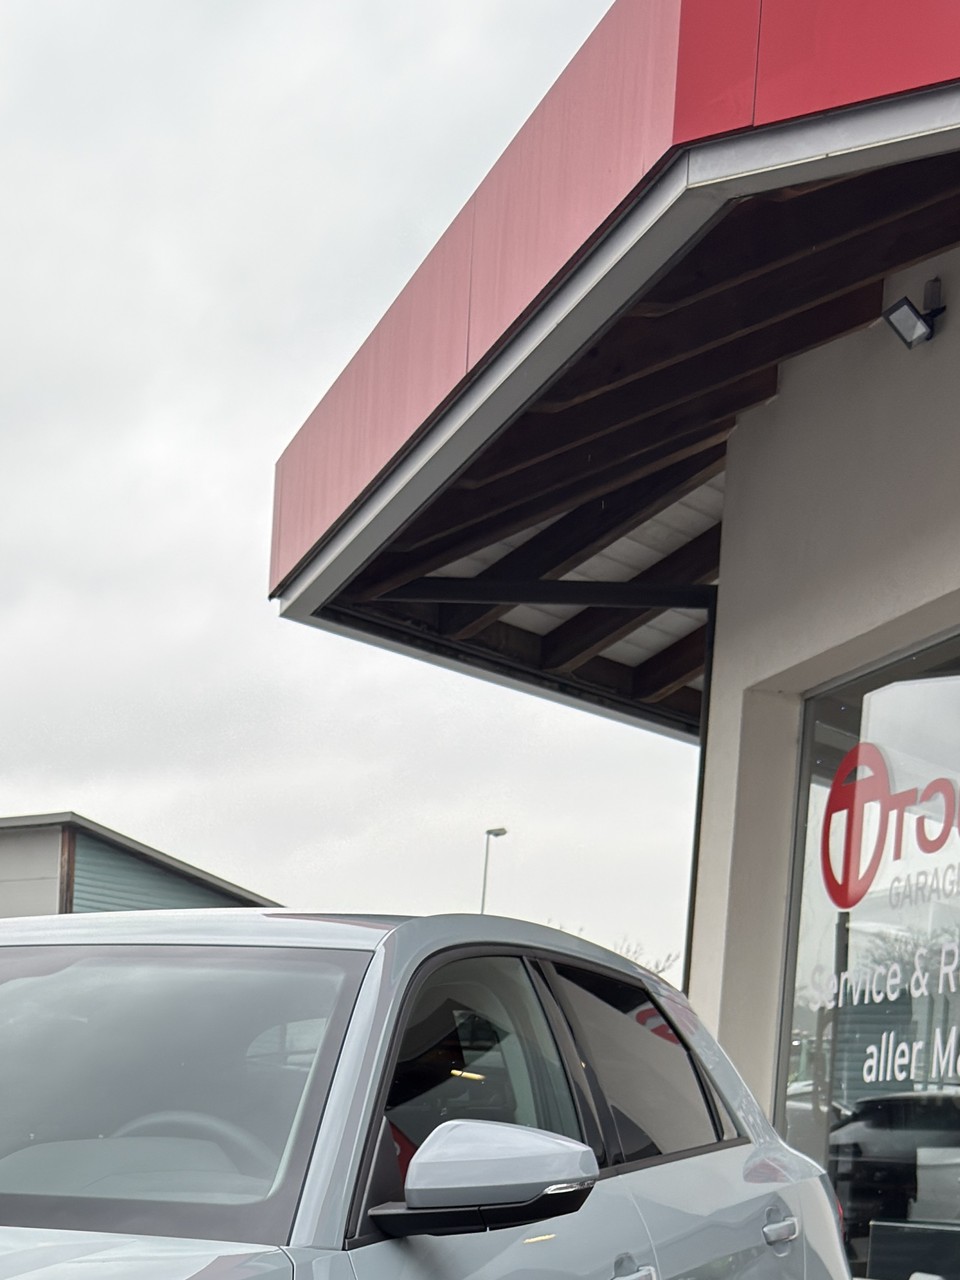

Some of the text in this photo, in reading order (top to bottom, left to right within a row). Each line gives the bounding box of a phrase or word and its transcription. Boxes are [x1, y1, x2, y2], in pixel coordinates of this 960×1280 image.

[888, 777, 960, 862] TO
[809, 963, 902, 1012] Service
[910, 948, 929, 998] &
[863, 1026, 960, 1083] aller M
